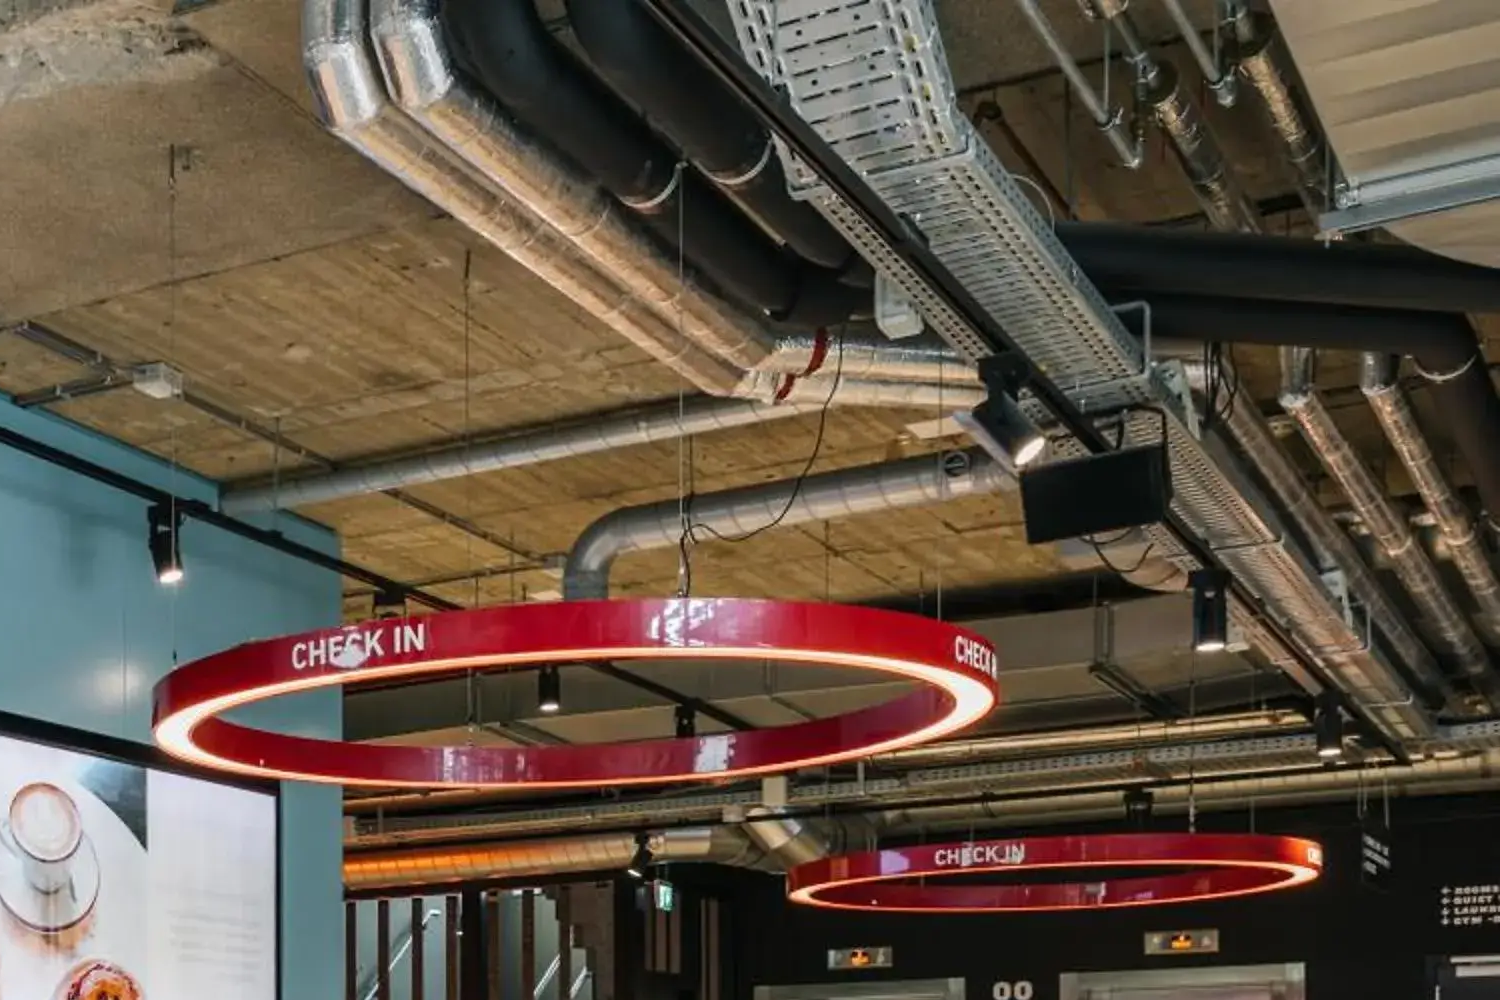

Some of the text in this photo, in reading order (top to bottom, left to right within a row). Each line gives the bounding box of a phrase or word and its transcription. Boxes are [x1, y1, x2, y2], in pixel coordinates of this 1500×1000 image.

[291, 623, 426, 669] CHECK IN
[934, 845, 999, 867] CHECK
